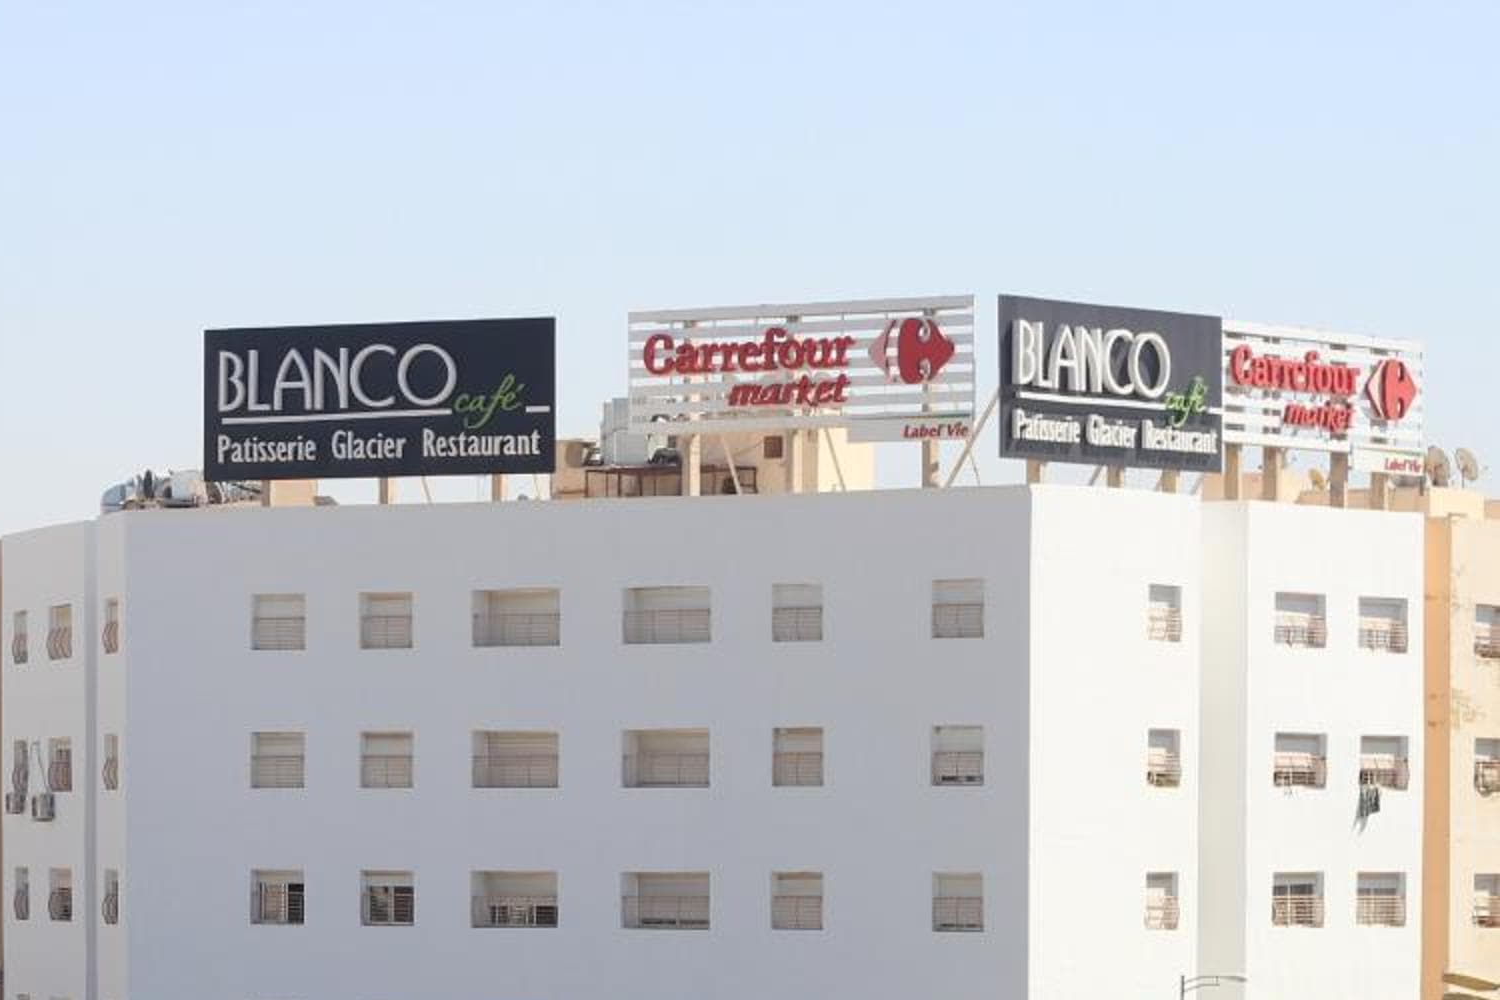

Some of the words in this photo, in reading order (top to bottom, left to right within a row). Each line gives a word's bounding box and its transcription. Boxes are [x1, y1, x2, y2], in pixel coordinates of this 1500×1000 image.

[643, 326, 856, 376] Carrefour
[1011, 317, 1172, 397] BLANCO
[1230, 345, 1361, 394] Carrefour
[217, 343, 457, 412] BLANCO
[452, 373, 526, 430] café
[727, 373, 851, 407] market
[1085, 414, 1137, 448] Glacier
[1141, 419, 1217, 454] Restaurant
[1283, 400, 1356, 433] market
[217, 434, 316, 465] Patisserie
[331, 429, 407, 460] Glacier
[422, 427, 541, 458] Restaurant
